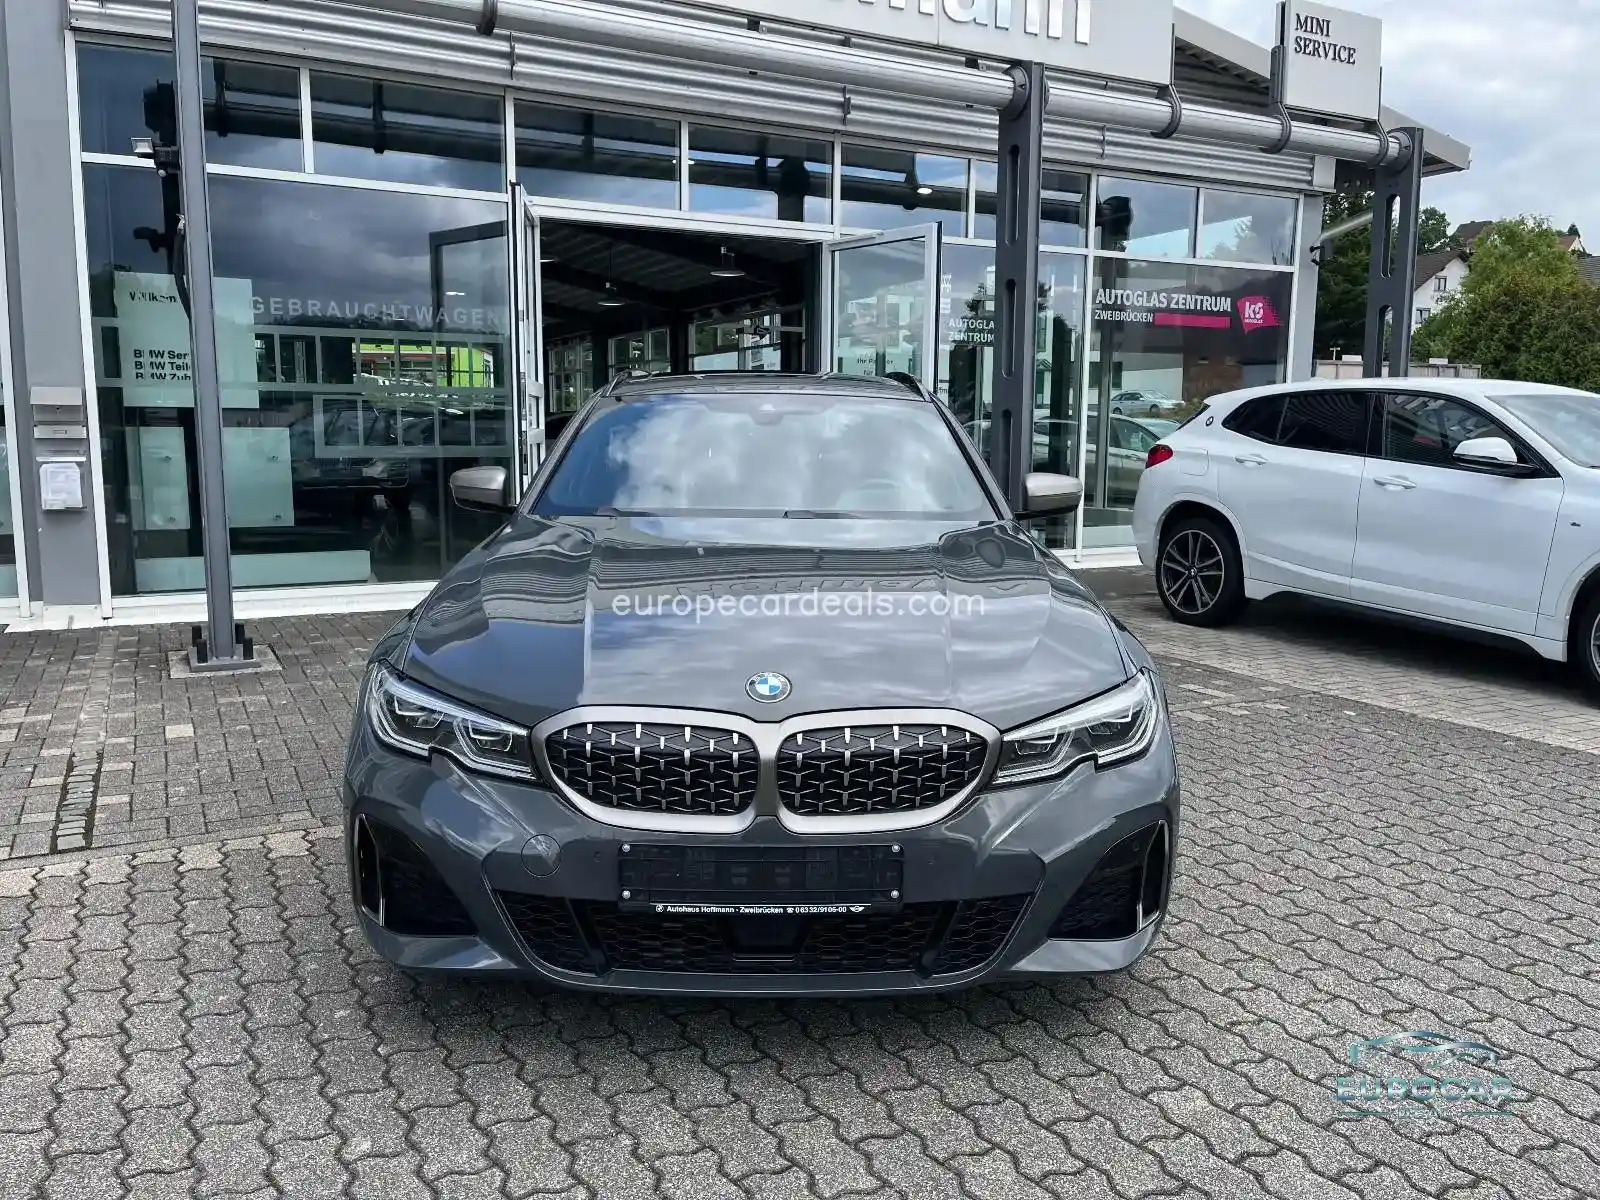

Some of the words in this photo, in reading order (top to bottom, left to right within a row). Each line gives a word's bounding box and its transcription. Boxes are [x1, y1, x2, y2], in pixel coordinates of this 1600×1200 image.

[1295, 13, 1331, 37] MINI
[1294, 35, 1356, 64] SERVICE
[1095, 289, 1167, 308] AUTOGLAS
[1170, 293, 1231, 312] ZENTRUM
[250, 296, 499, 325] GEBRAUCHTWAGEN
[1094, 310, 1154, 323] ZWEIBRÜCKEN
[949, 319, 995, 329] AUTOGLA
[948, 331, 995, 342] ZENTRUM
[168, 350, 190, 360] Ser
[169, 361, 190, 371] Teil
[740, 906, 784, 914] Zweibrücken
